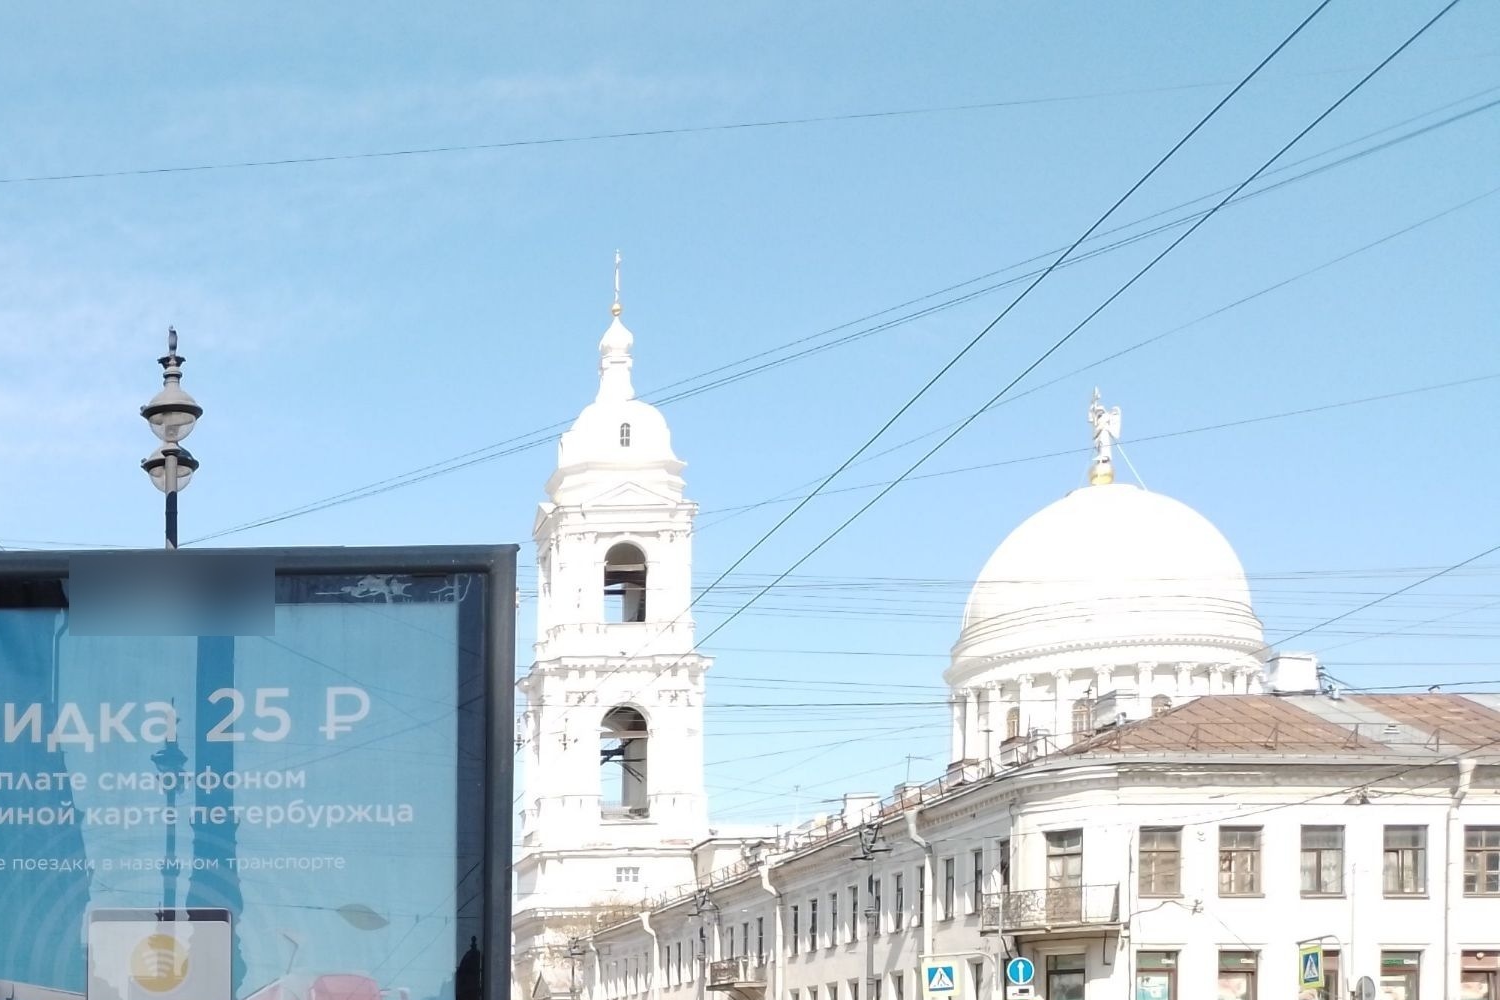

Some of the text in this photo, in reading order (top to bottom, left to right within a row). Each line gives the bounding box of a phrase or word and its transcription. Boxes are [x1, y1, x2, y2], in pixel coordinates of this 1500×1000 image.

[205, 686, 291, 743] 25
[97, 764, 306, 794] смартфоном
[87, 804, 178, 830] карте
[190, 800, 414, 831] петербуржца
[12, 856, 95, 873] поездки
[119, 858, 219, 871] наземном
[226, 857, 346, 873] транспорте
